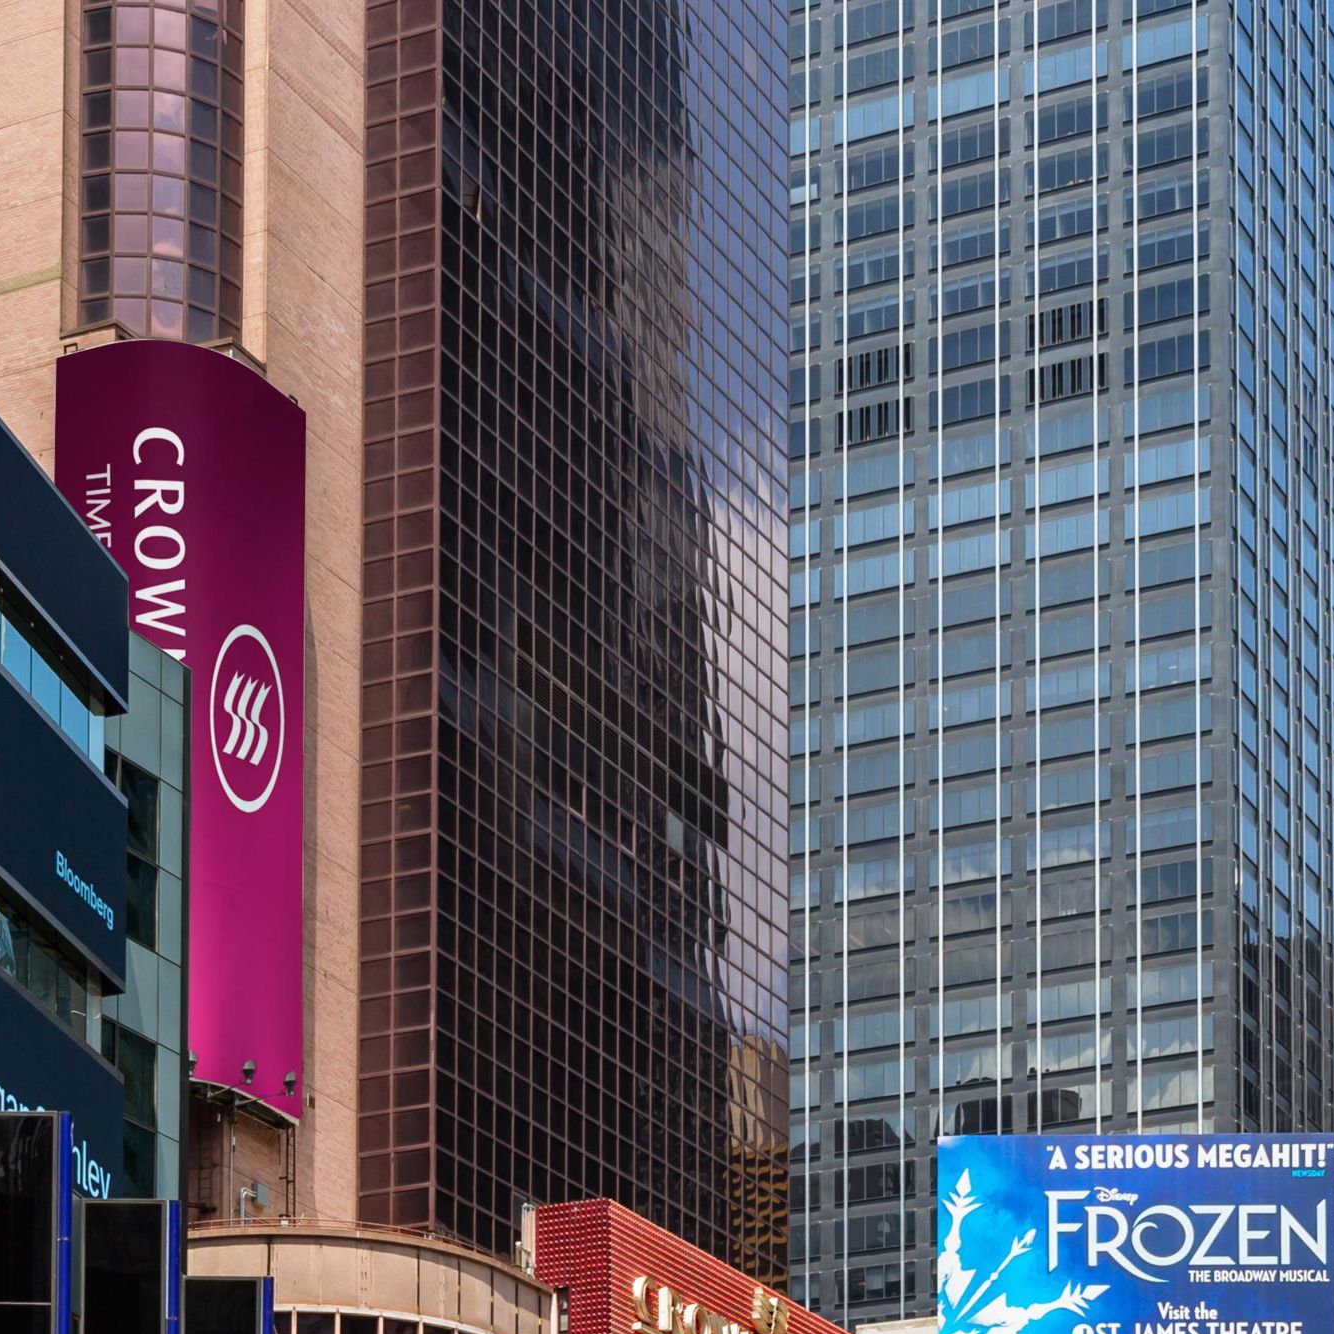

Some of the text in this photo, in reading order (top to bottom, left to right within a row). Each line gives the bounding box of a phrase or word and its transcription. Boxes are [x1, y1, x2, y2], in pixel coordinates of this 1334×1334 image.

[133, 427, 187, 663] CROW
[56, 850, 114, 929] Bloomberg
[1075, 1144, 1189, 1169] SERIOUS
[1044, 1190, 1327, 1283] FROZEN
[1188, 1269, 1330, 1283] THE BROADWAY MUSICAL
[1157, 1301, 1218, 1320] Visit the
